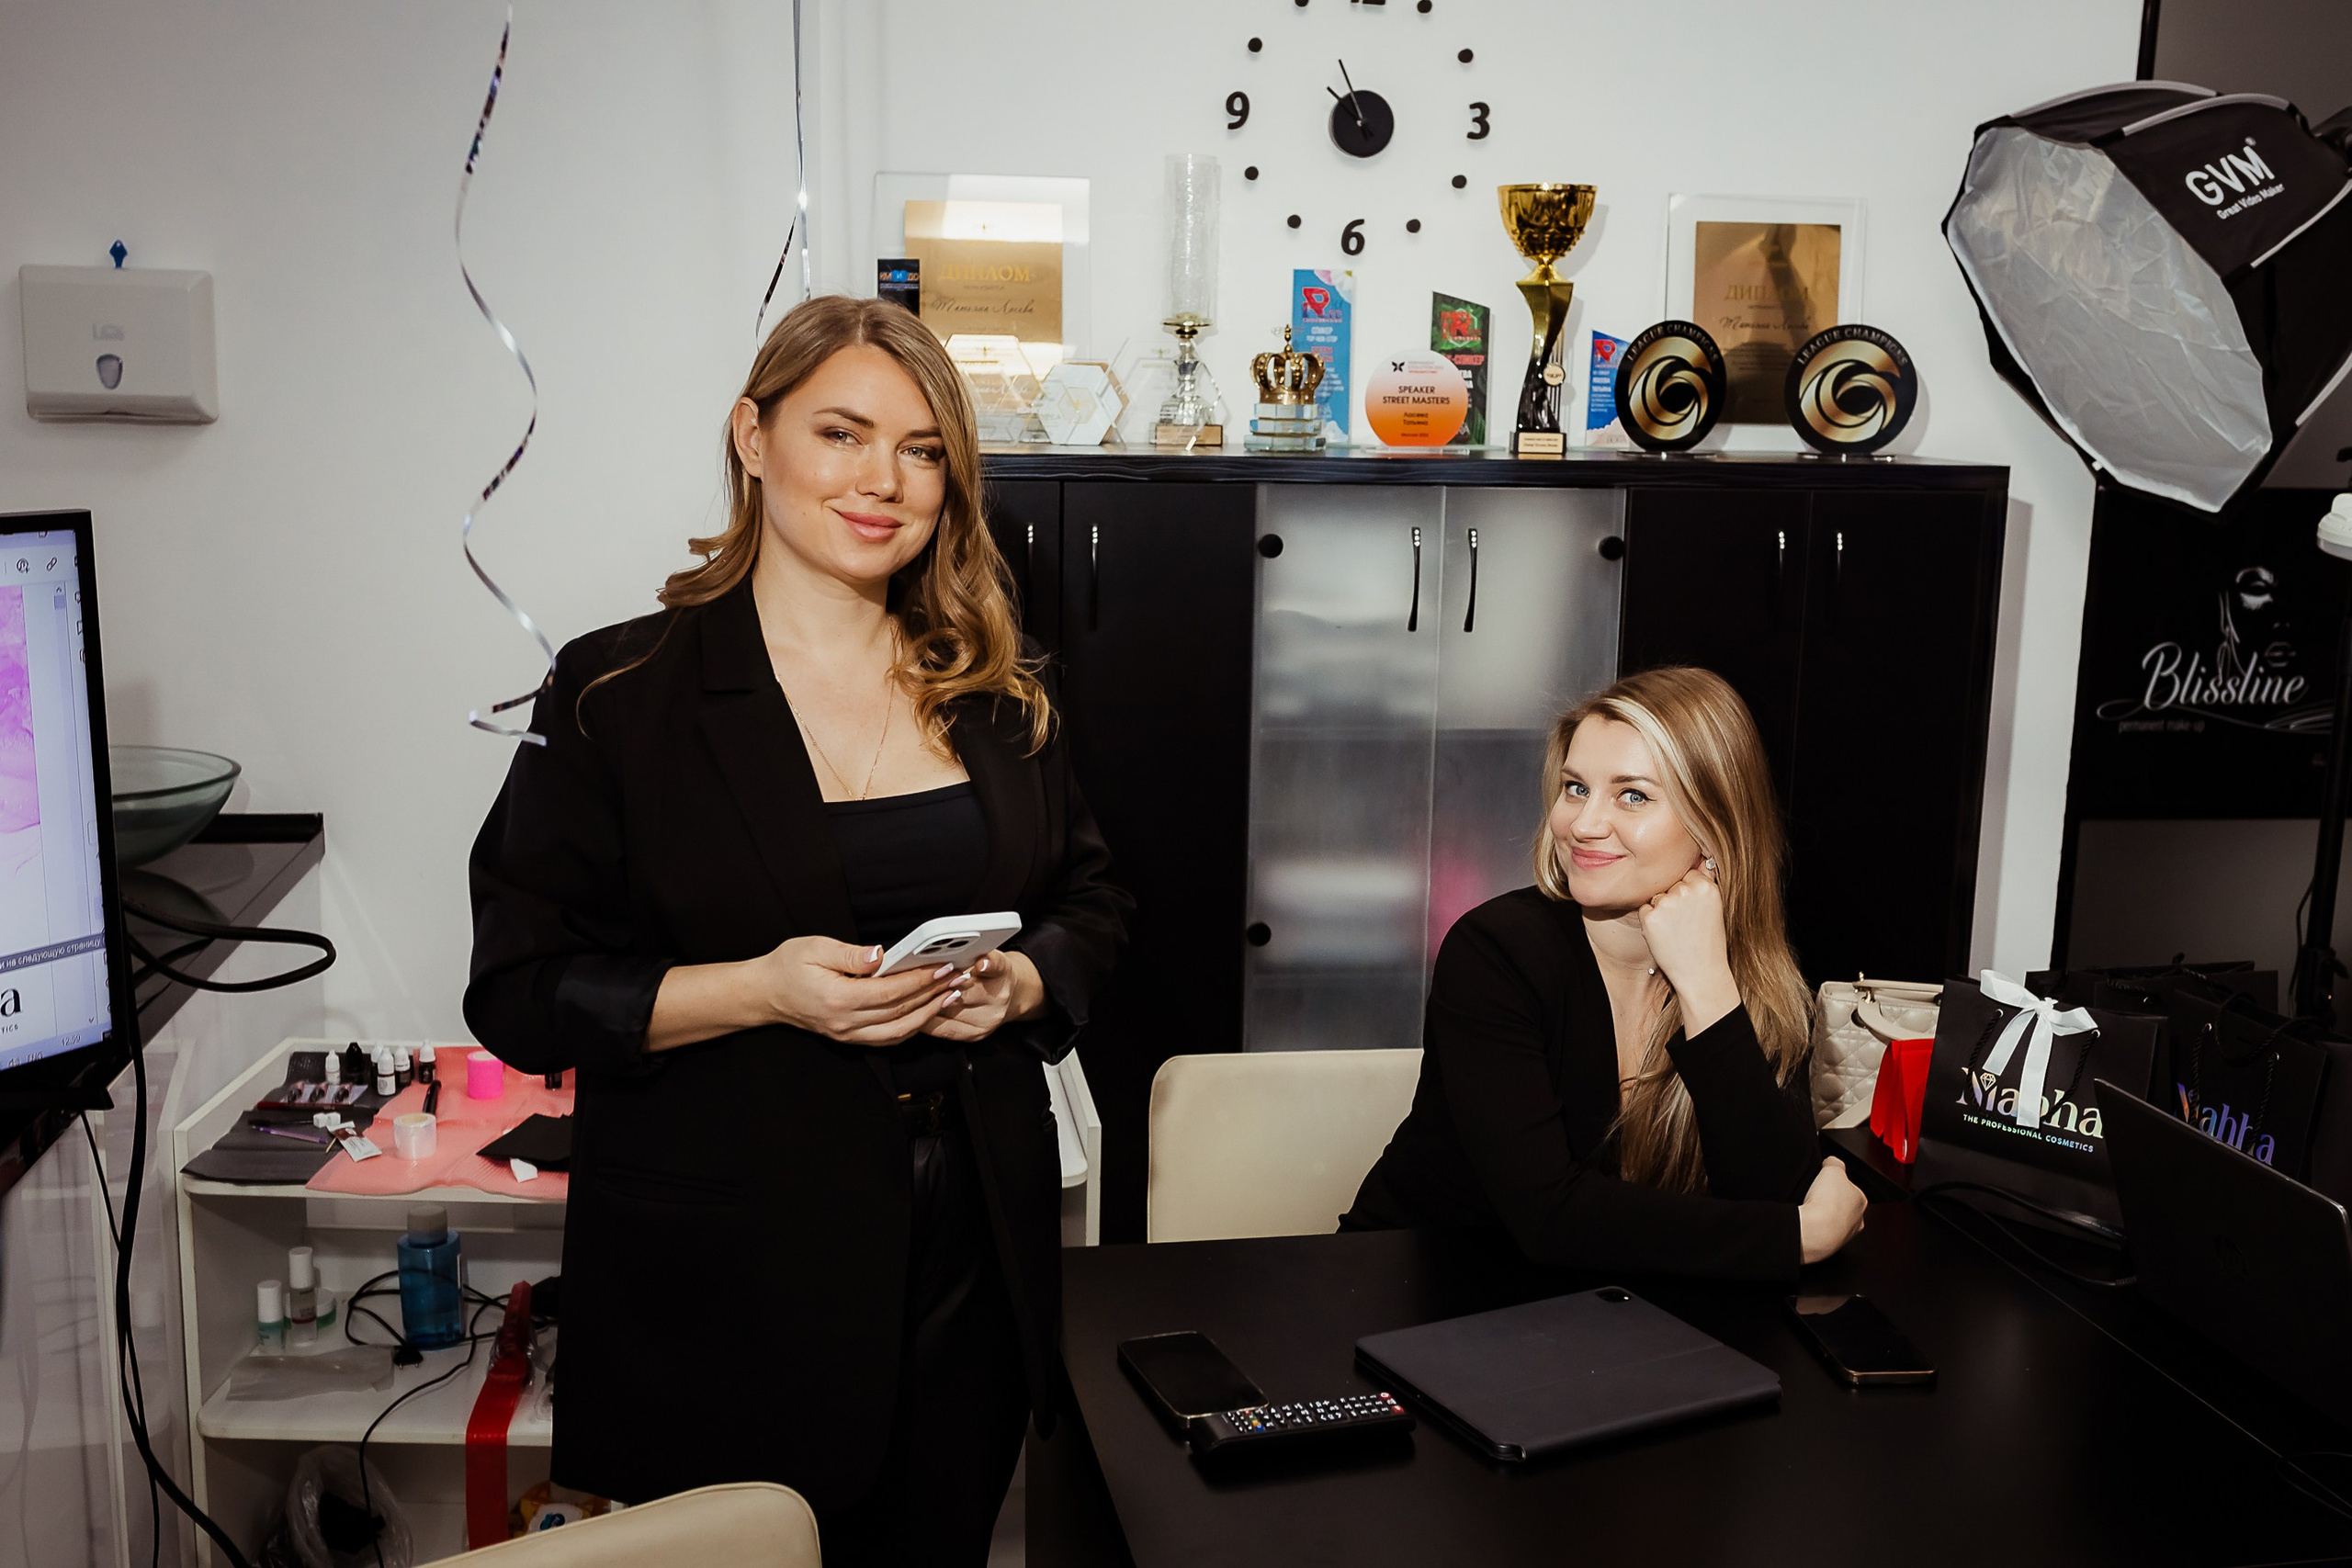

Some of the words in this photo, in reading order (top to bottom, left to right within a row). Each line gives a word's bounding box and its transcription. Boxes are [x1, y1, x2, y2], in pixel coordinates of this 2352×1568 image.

[1226, 90, 1250, 130] 9
[1466, 101, 1491, 141] 3
[2184, 144, 2276, 207] GVM
[2237, 193, 2263, 209] Video
[1340, 218, 1366, 256] 6
[1626, 325, 1665, 362] LEAGUE
[1796, 329, 1841, 366] LEAGUE
[1843, 327, 1909, 367] CHAMPIONS
[1382, 395, 1409, 405] STREET
[1411, 395, 1451, 405] MASTERS
[1398, 385, 1435, 394] SPEAKER
[2141, 640, 2308, 712] Blissline
[1962, 1113, 1980, 1125] THE
[1980, 1118, 2043, 1142] PROFESSIONAL
[2044, 1134, 2095, 1154] COSMETICS
